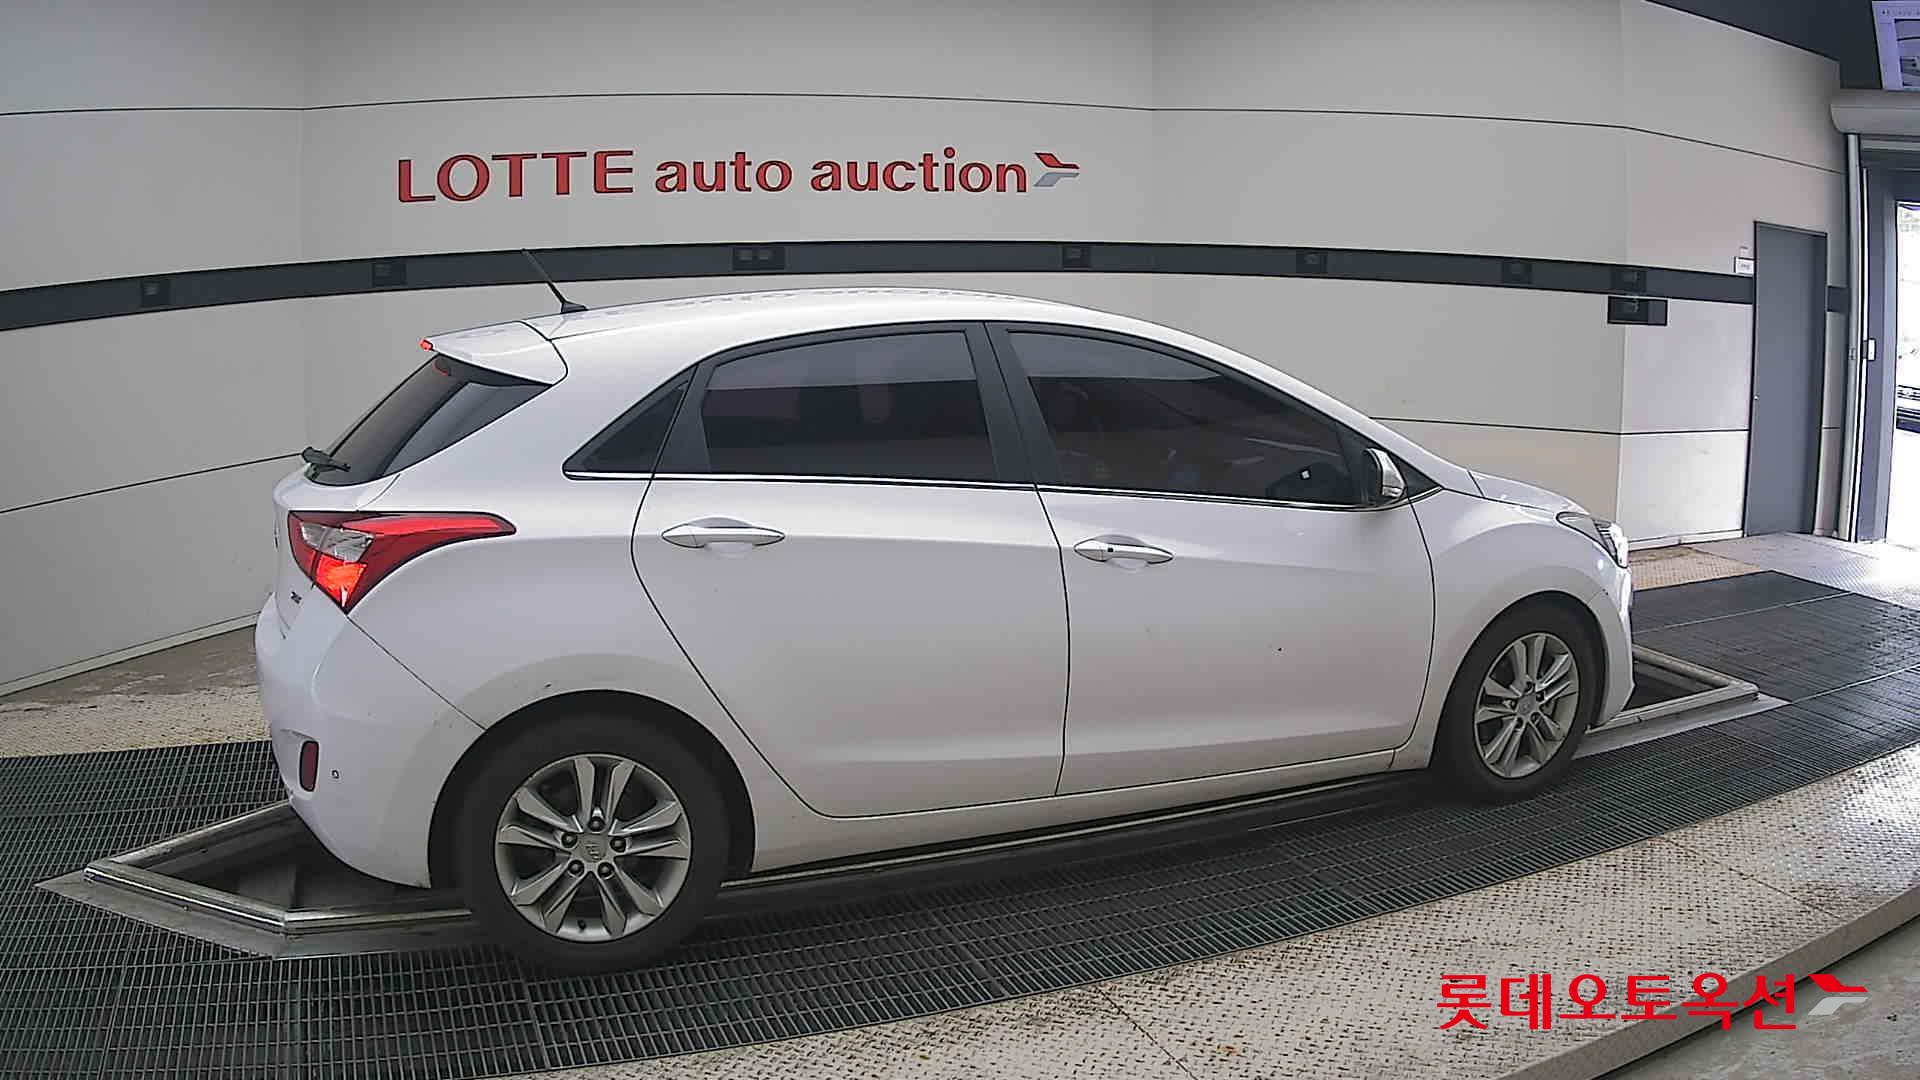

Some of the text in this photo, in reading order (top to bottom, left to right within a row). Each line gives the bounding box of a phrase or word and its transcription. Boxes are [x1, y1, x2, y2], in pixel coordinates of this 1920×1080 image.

[398, 146, 1029, 204] LOTTE auto auction
